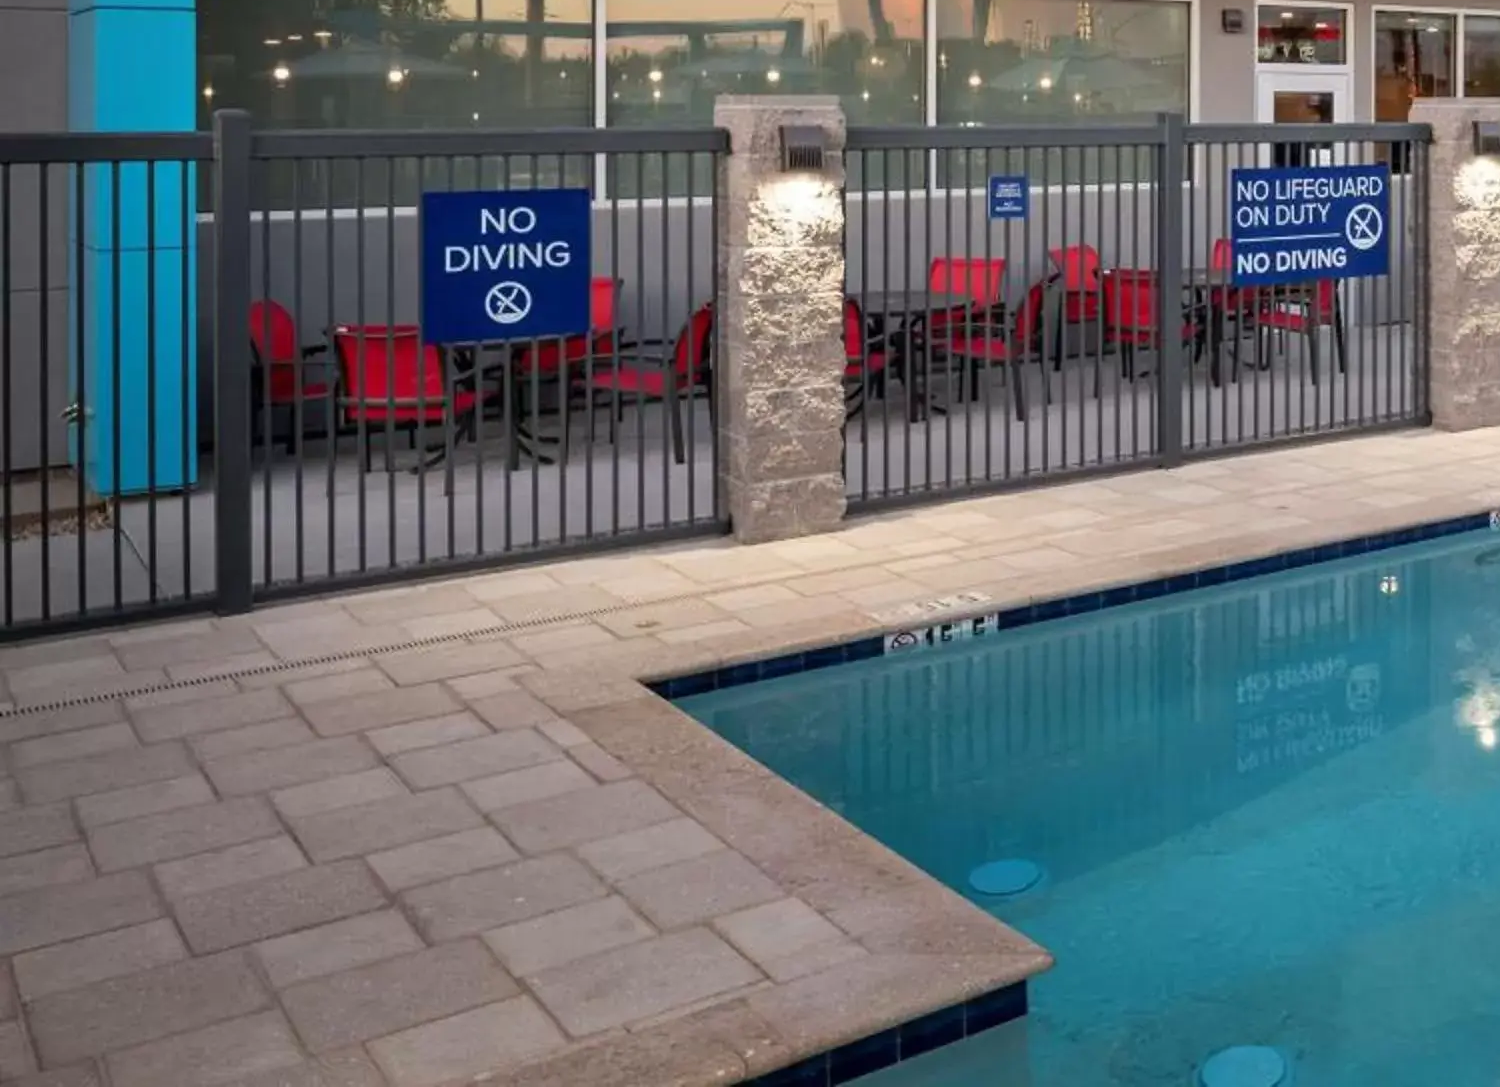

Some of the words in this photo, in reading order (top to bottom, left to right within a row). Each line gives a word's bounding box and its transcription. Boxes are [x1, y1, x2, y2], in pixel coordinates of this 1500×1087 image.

[1236, 180, 1269, 202] NO
[1275, 176, 1383, 200] LIFEGUARD
[480, 206, 537, 235] NO
[1236, 206, 1269, 228] ON
[1275, 202, 1331, 226] DUTY
[444, 241, 571, 273] DIVING
[1236, 252, 1270, 275] NO
[1276, 246, 1347, 272] DIVING
